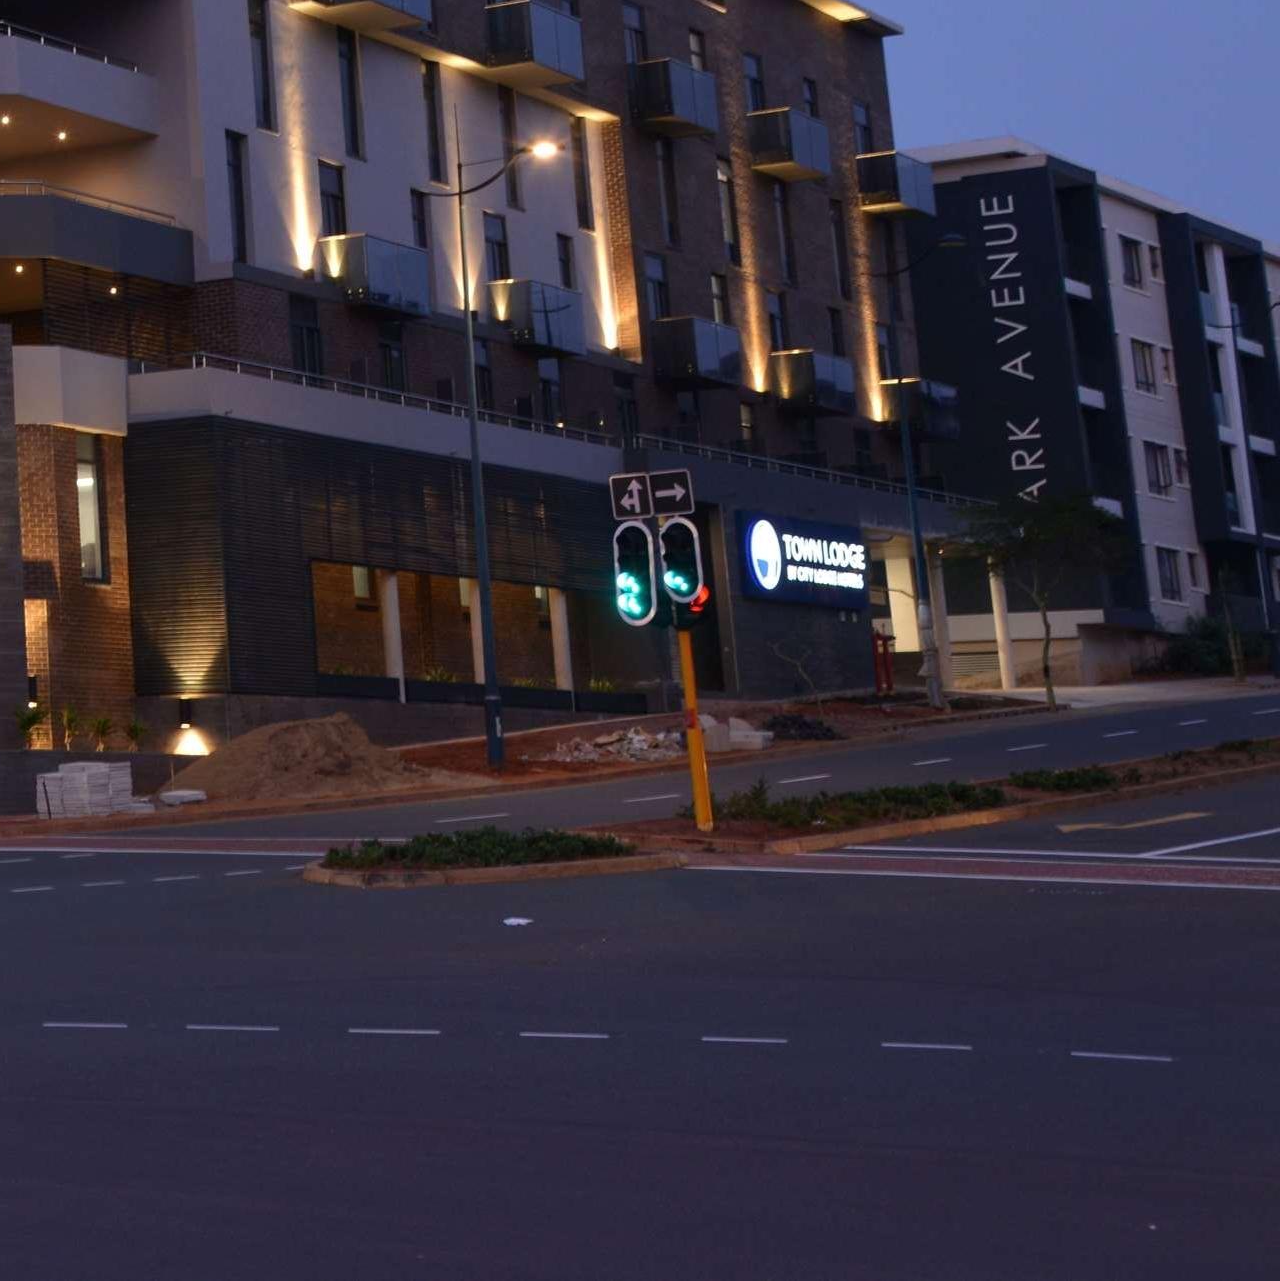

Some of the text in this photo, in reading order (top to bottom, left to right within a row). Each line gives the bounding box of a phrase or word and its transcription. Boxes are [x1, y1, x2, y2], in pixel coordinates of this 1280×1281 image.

[980, 194, 1047, 537] ARK AVENUE
[782, 534, 866, 570] TOWN LODGE
